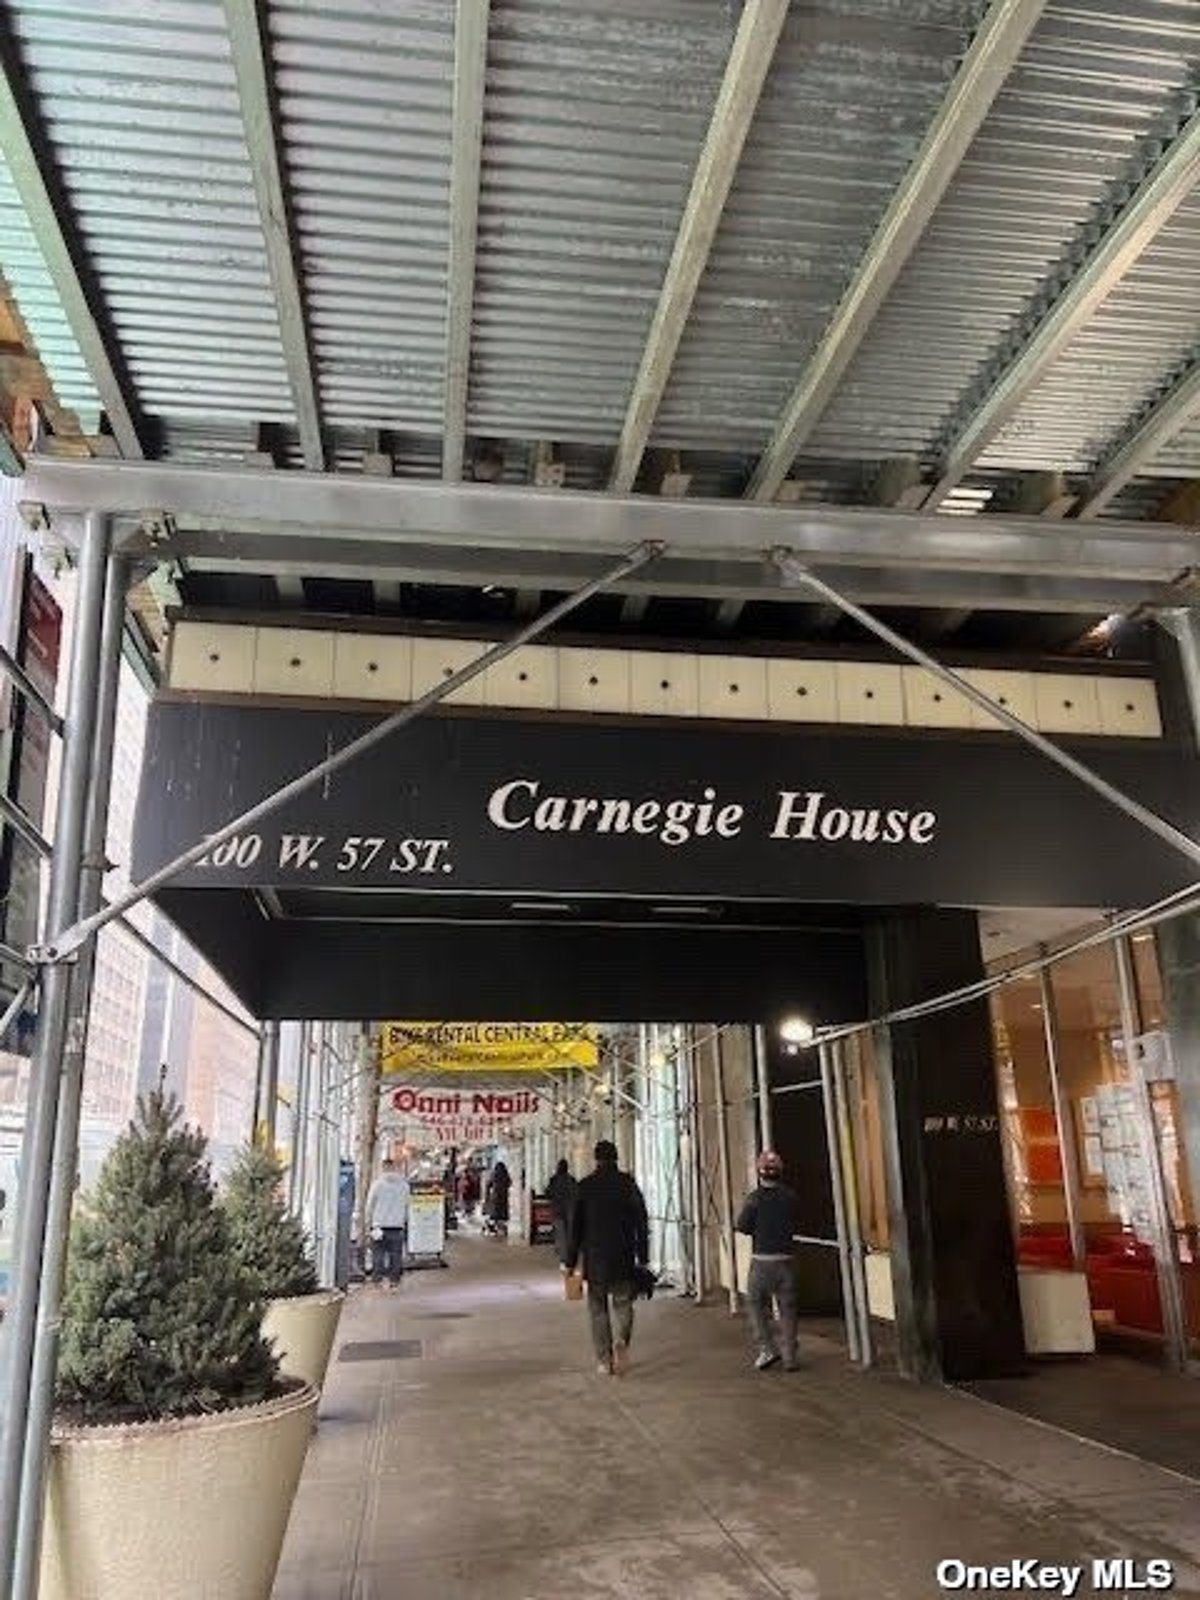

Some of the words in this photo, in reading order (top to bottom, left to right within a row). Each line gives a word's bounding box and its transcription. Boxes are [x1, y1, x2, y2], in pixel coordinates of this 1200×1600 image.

[487, 778, 744, 846] Carnegie
[770, 790, 937, 845] House
[279, 834, 325, 869] W.
[336, 837, 386, 871] 57
[389, 838, 453, 873] ST.
[472, 1091, 539, 1114] Nails
